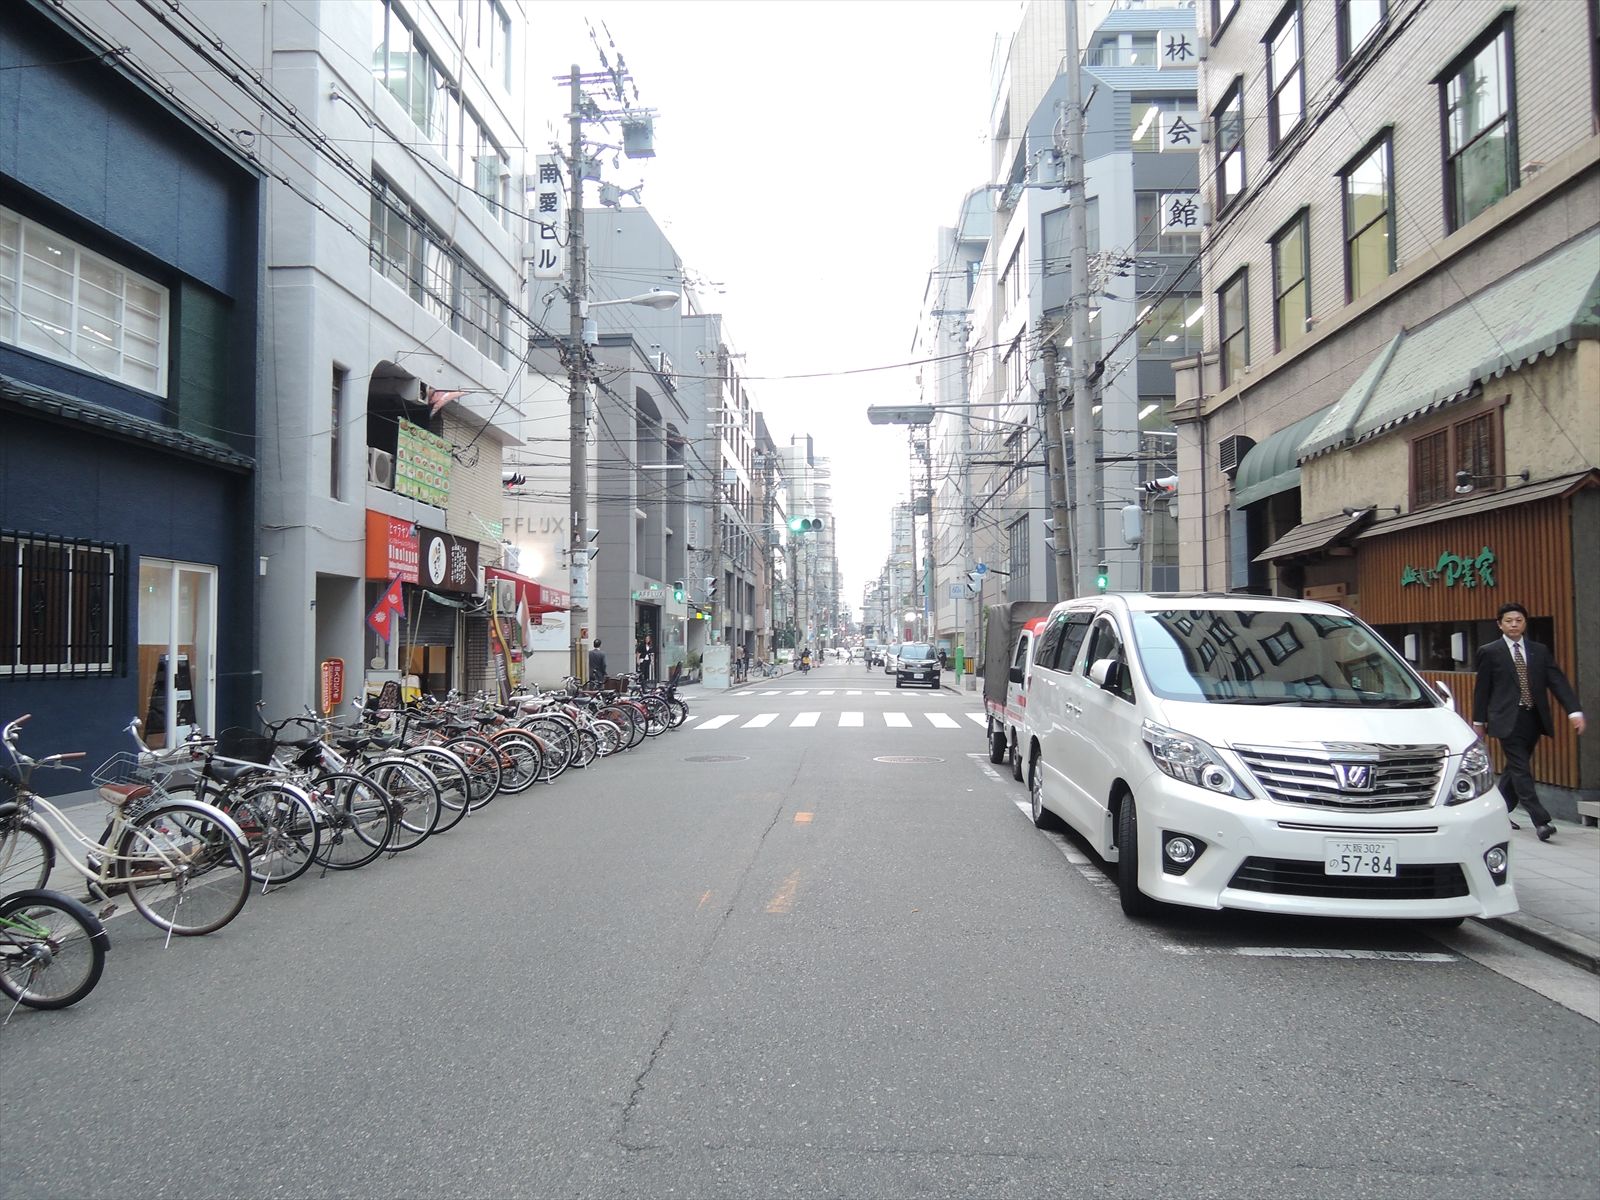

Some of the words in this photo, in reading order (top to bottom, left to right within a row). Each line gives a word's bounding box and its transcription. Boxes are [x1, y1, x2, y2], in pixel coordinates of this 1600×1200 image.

[1164, 34, 1199, 228] 林会館
[538, 163, 558, 269] 南愛ビル
[1329, 858, 1339, 868] の
[1341, 855, 1392, 874] 57-84
